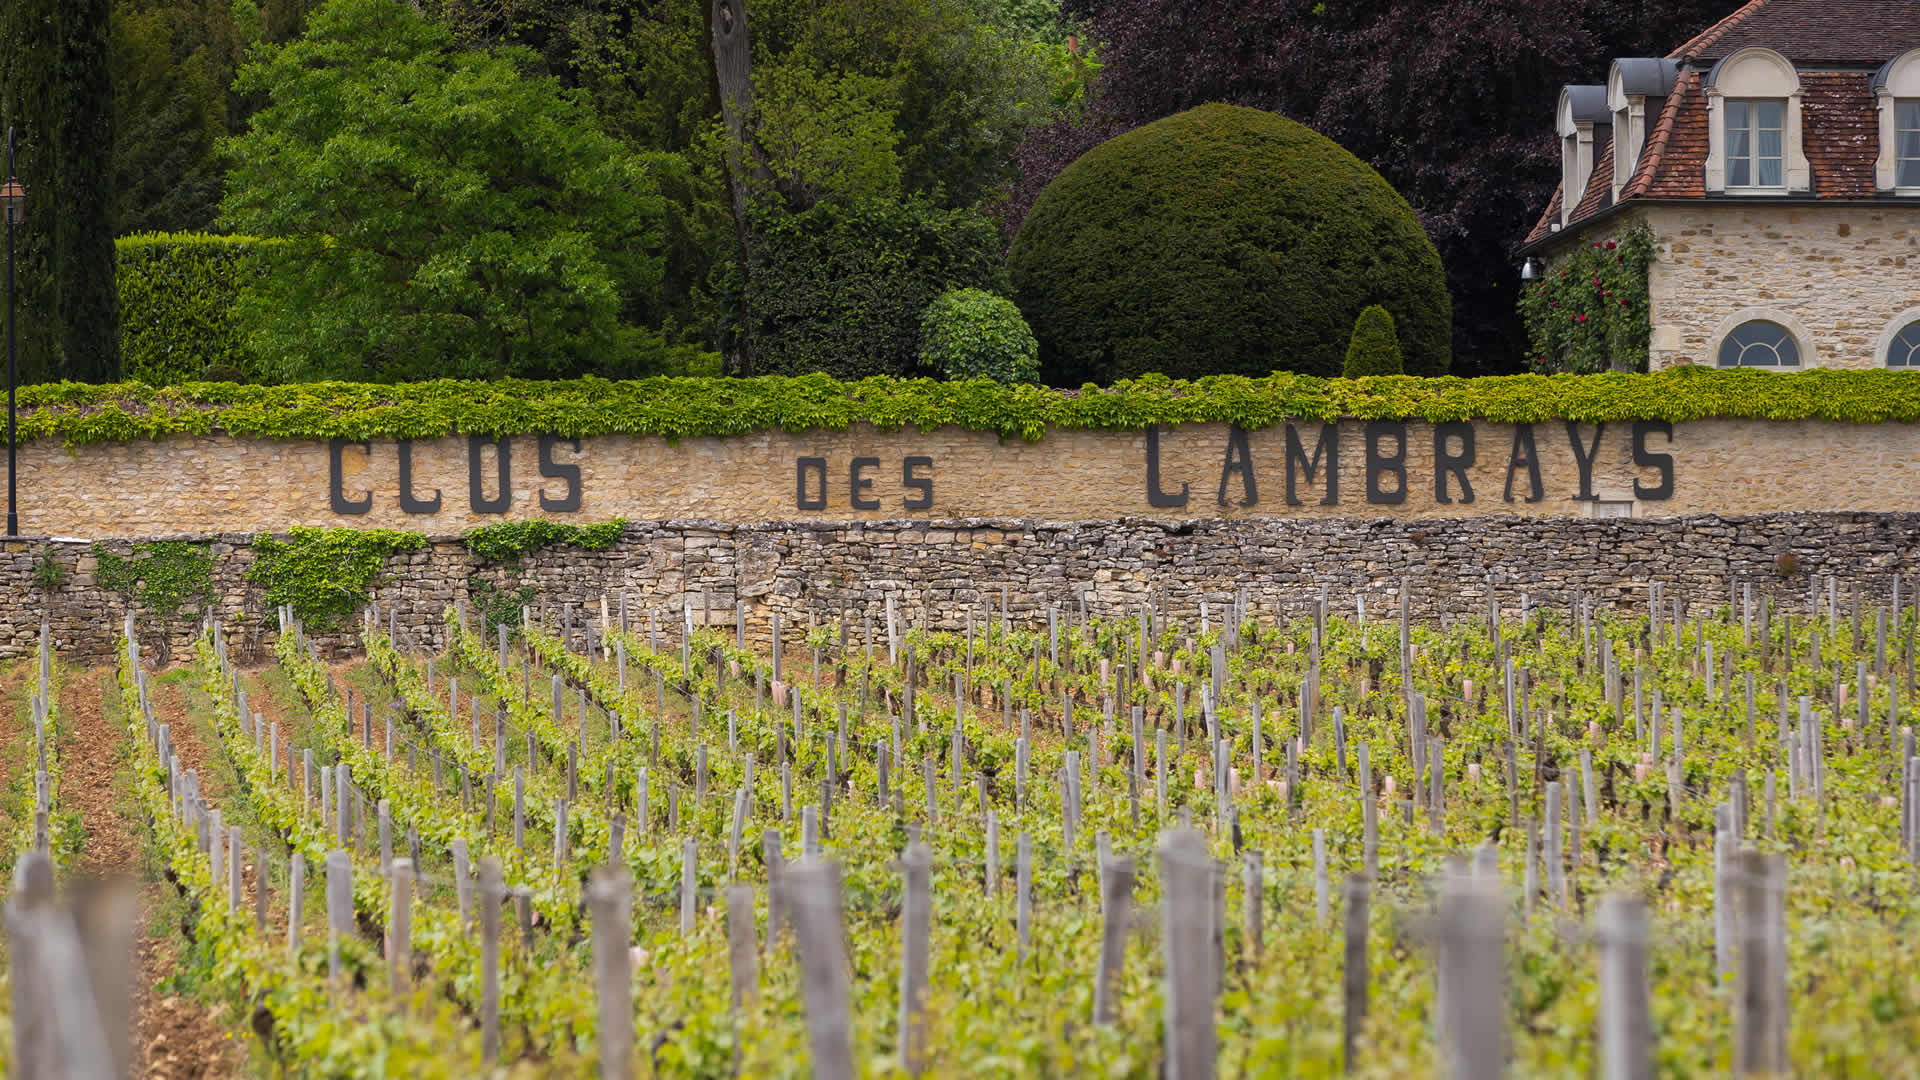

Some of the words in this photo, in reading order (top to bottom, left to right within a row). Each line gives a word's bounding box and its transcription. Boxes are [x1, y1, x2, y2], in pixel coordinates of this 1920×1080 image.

[330, 432, 581, 514] CLOS
[797, 456, 932, 510] DES
[1146, 418, 1674, 507] LAMBRAYS
